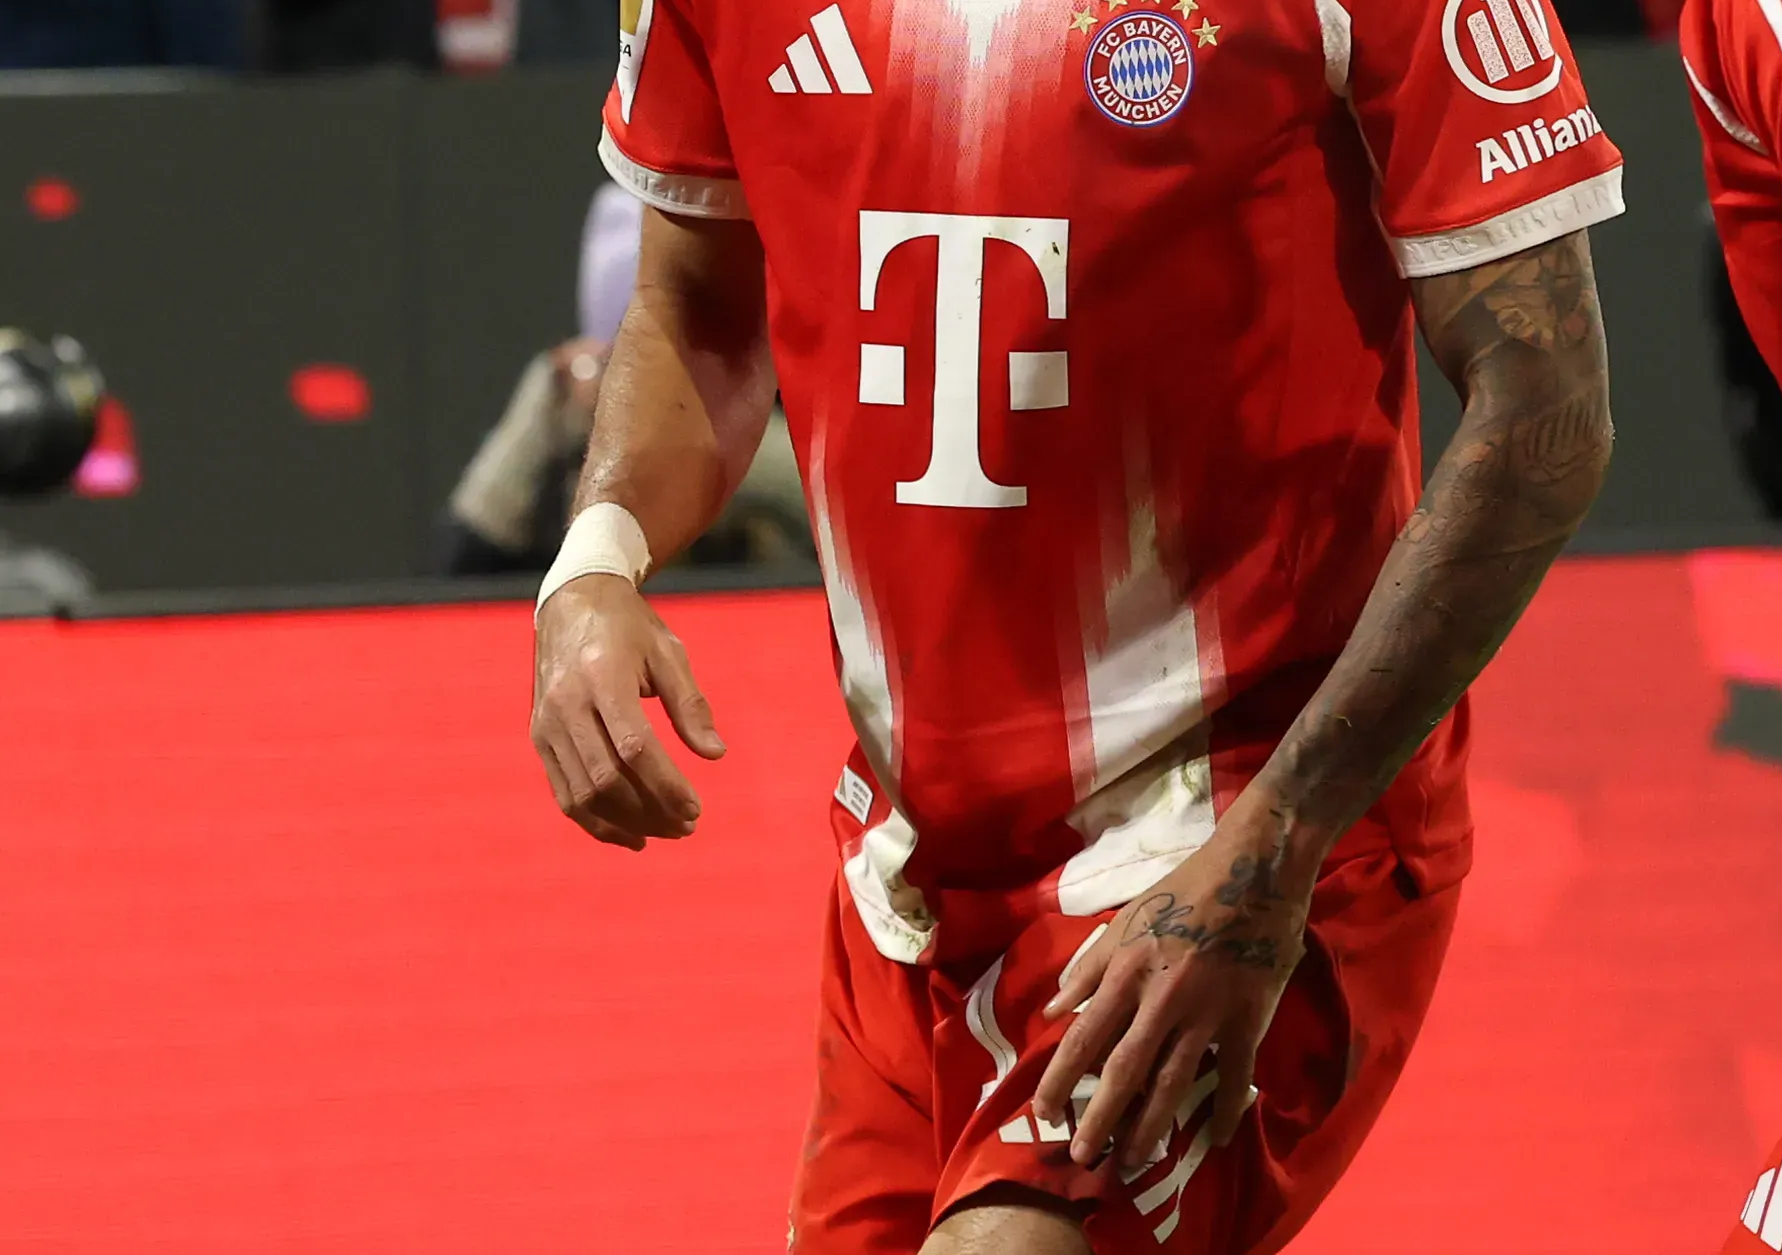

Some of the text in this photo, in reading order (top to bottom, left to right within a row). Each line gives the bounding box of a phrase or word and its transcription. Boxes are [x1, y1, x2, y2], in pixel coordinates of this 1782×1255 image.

[1096, 19, 1188, 66] FC BAYERN
[1092, 74, 1184, 120] MÜNCHEN
[858, 209, 1070, 509] T
